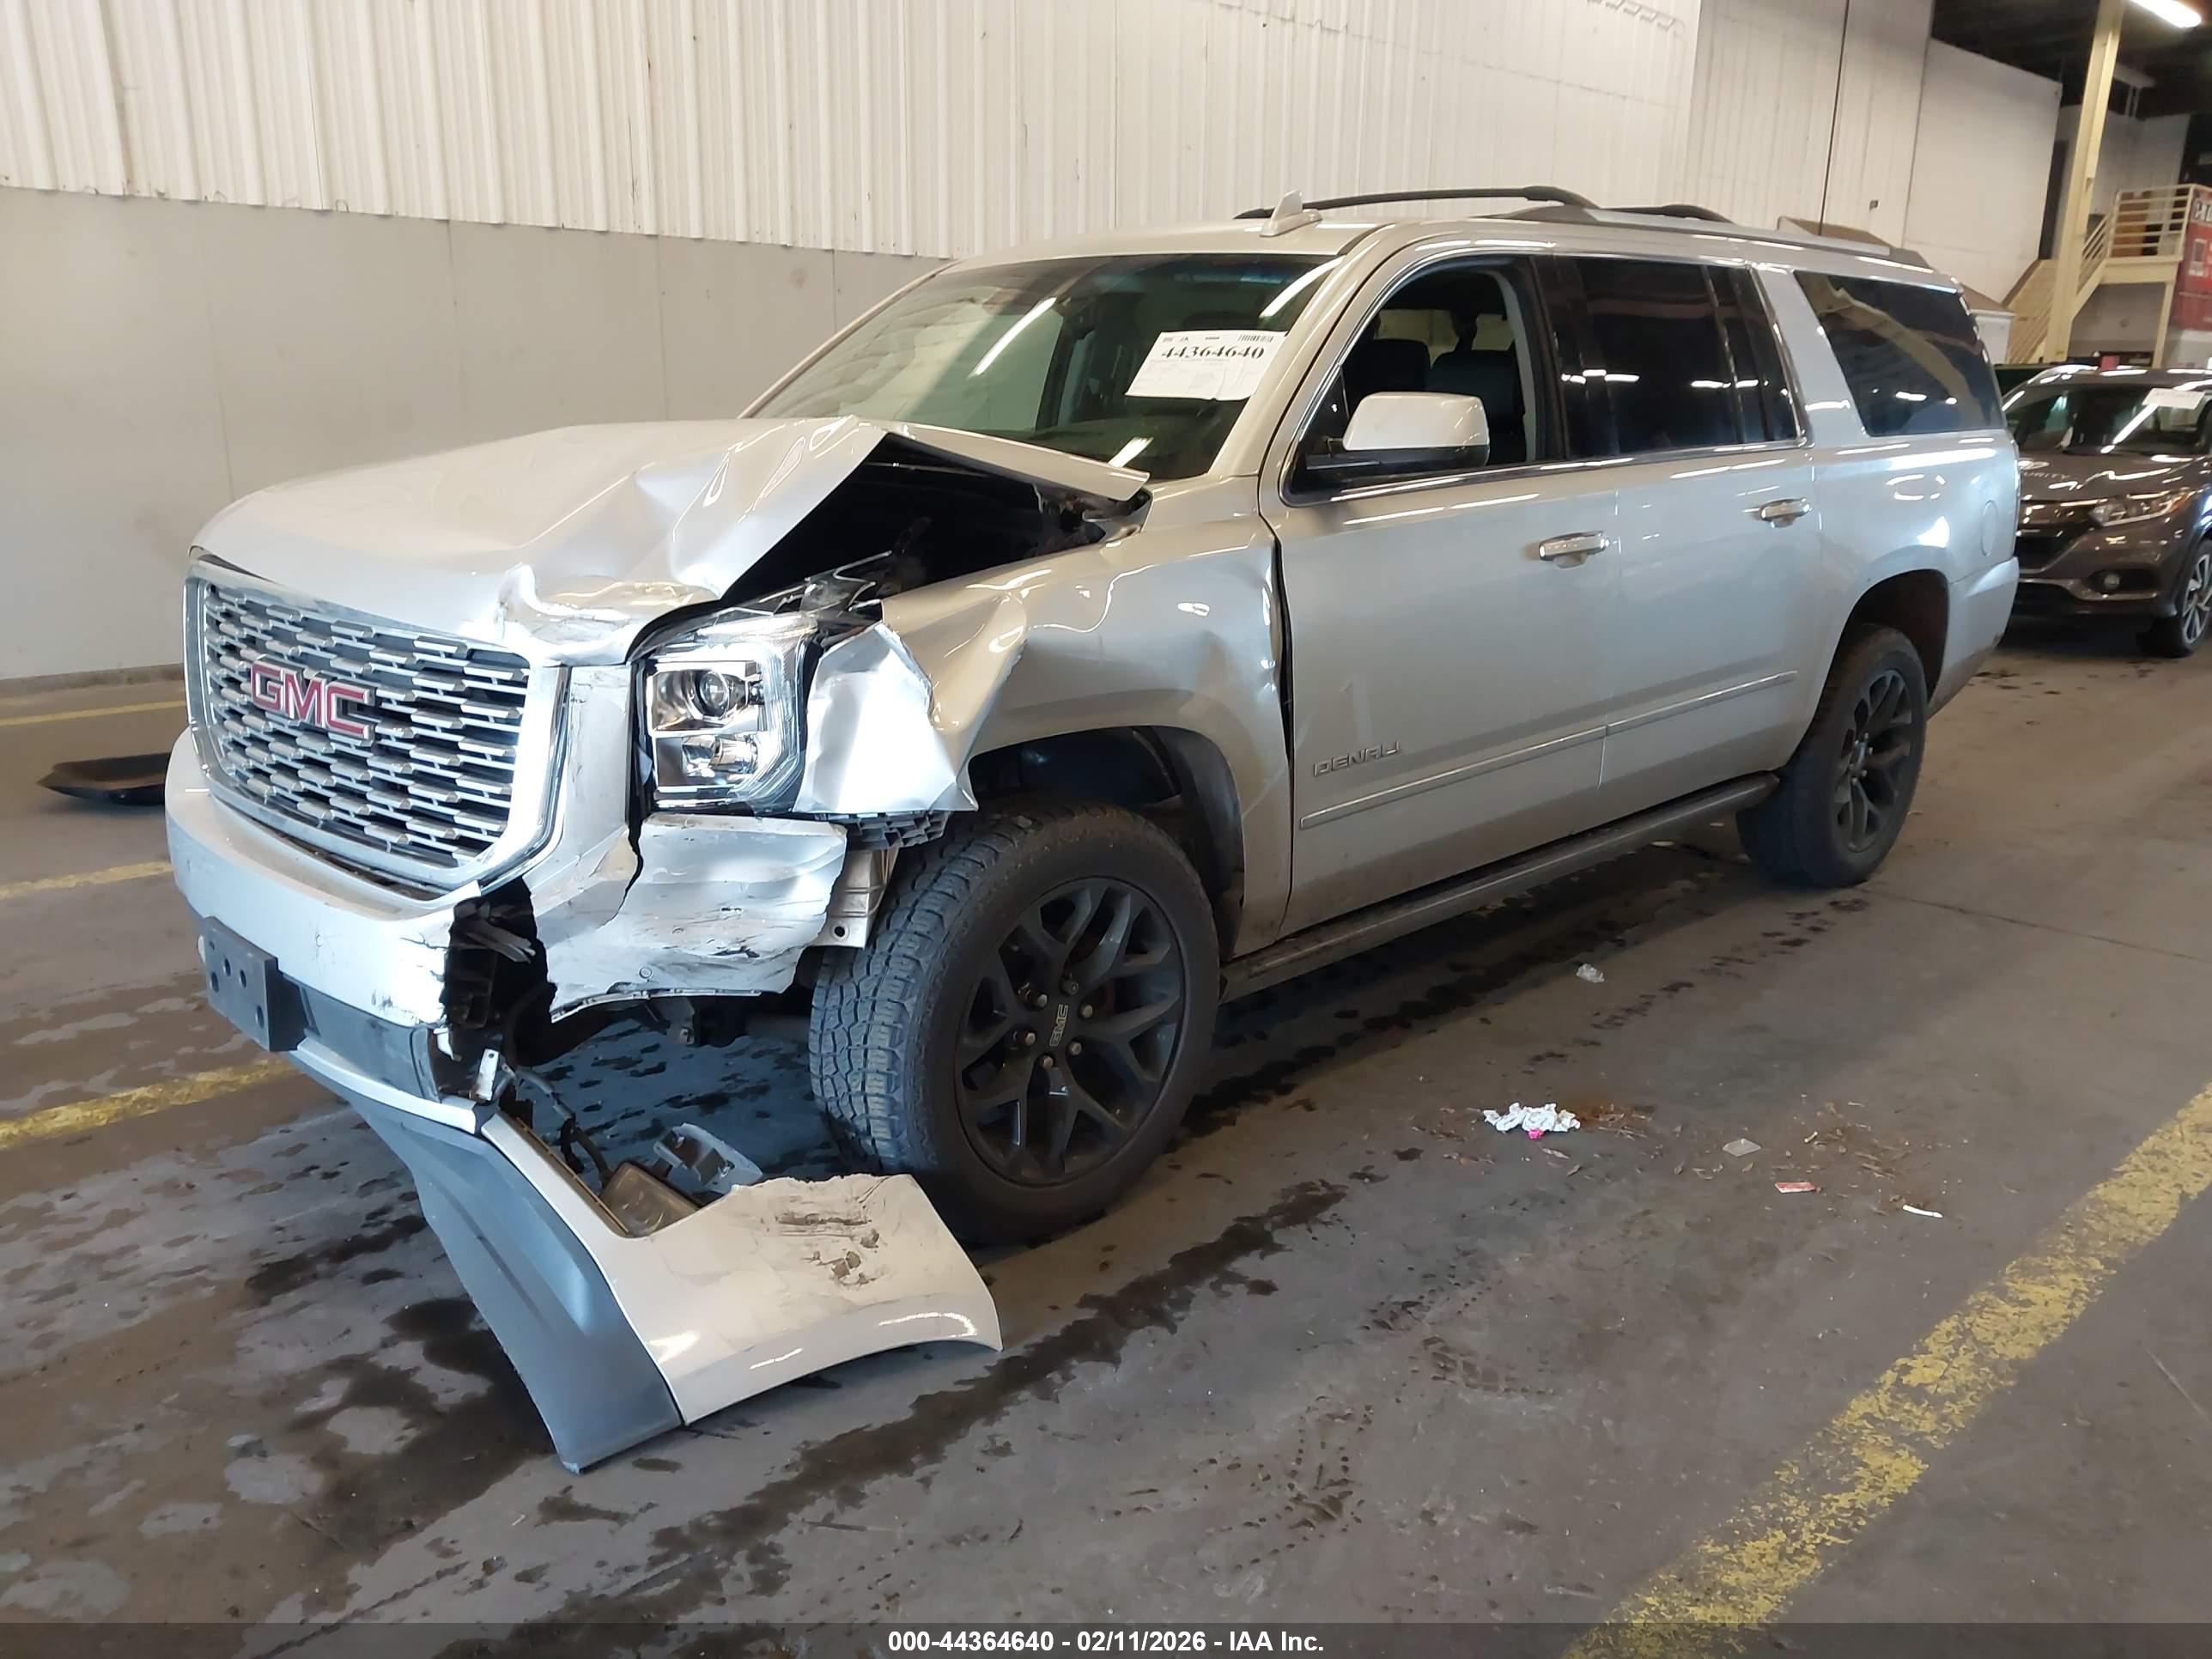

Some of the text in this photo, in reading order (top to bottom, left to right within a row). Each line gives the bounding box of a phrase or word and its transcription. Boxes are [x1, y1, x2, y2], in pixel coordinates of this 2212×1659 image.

[1161, 345, 1265, 359] 44364640
[250, 660, 373, 742] GMC
[1313, 741, 1401, 777] DENALI
[1049, 1003, 1069, 1047] GMC
